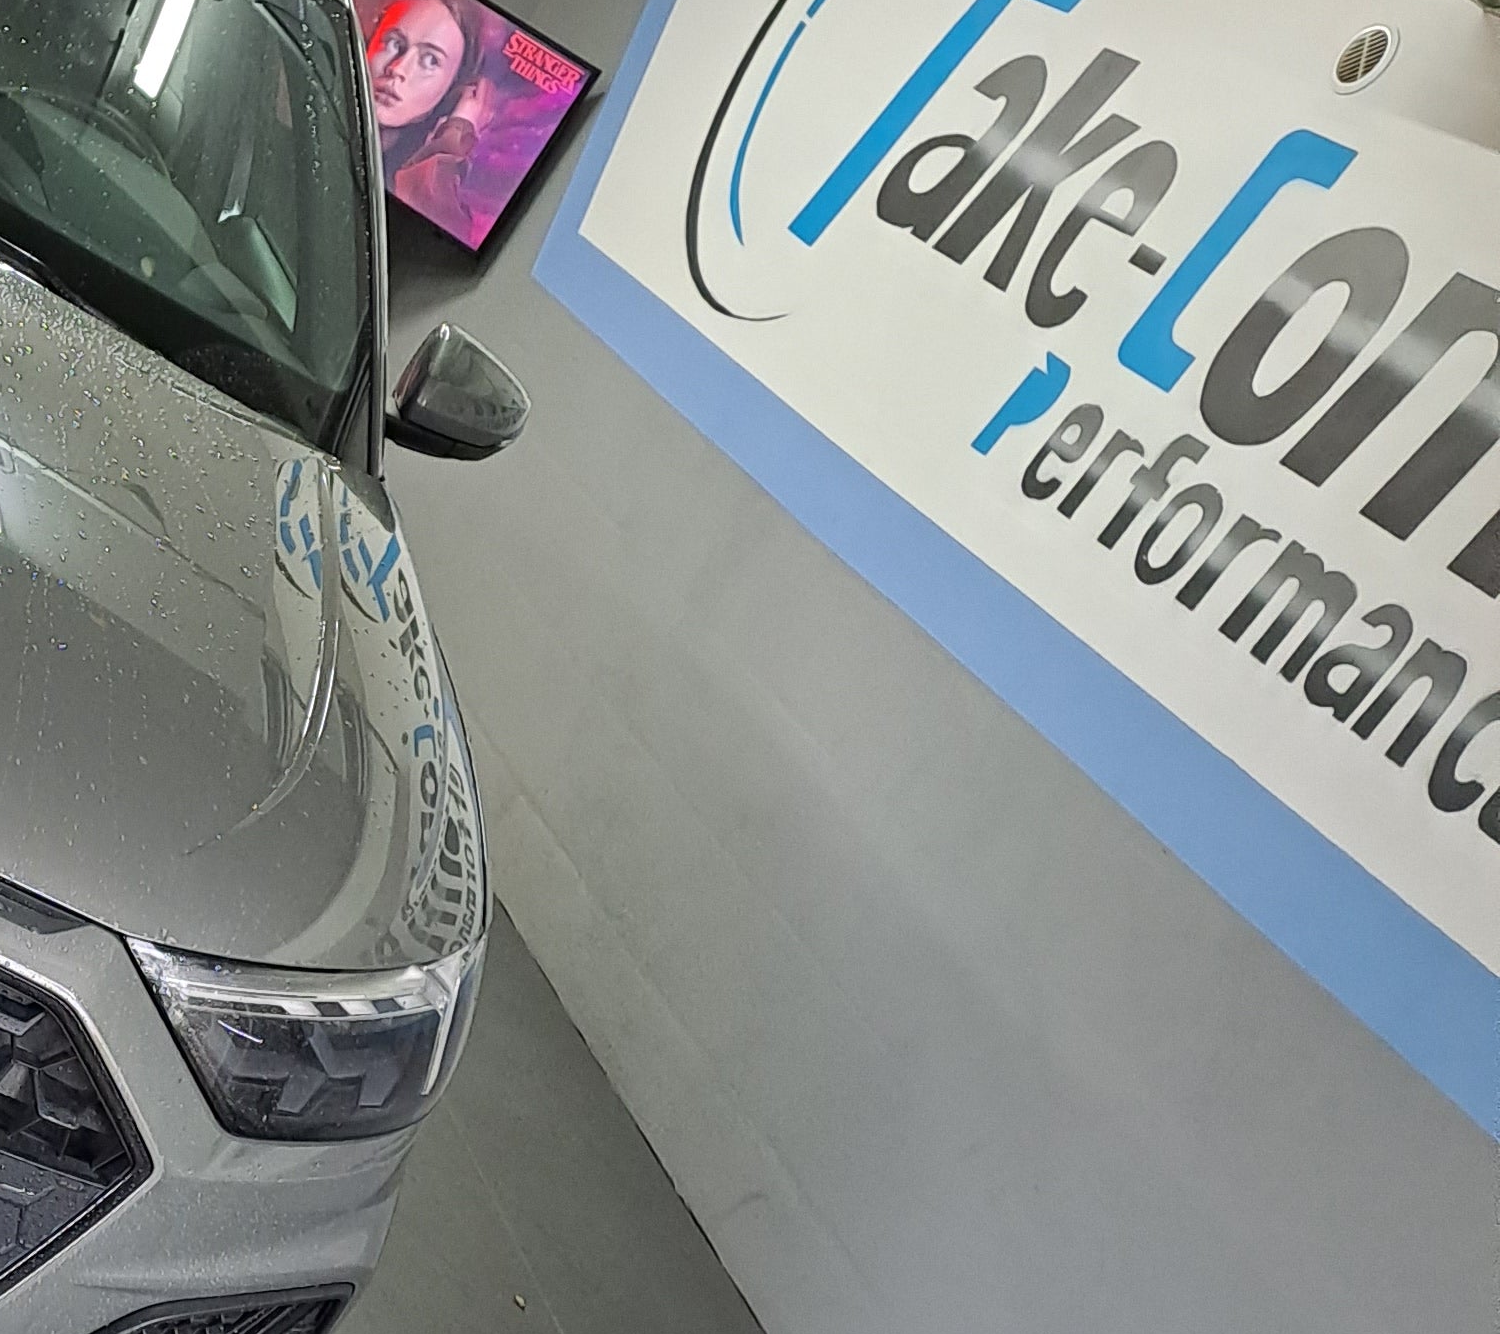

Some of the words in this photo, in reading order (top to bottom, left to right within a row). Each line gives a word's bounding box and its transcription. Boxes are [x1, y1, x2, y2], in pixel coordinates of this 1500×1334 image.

[506, 33, 581, 93] STRANGER
[510, 56, 560, 94] THINGS
[971, 351, 1500, 845] Performanc
